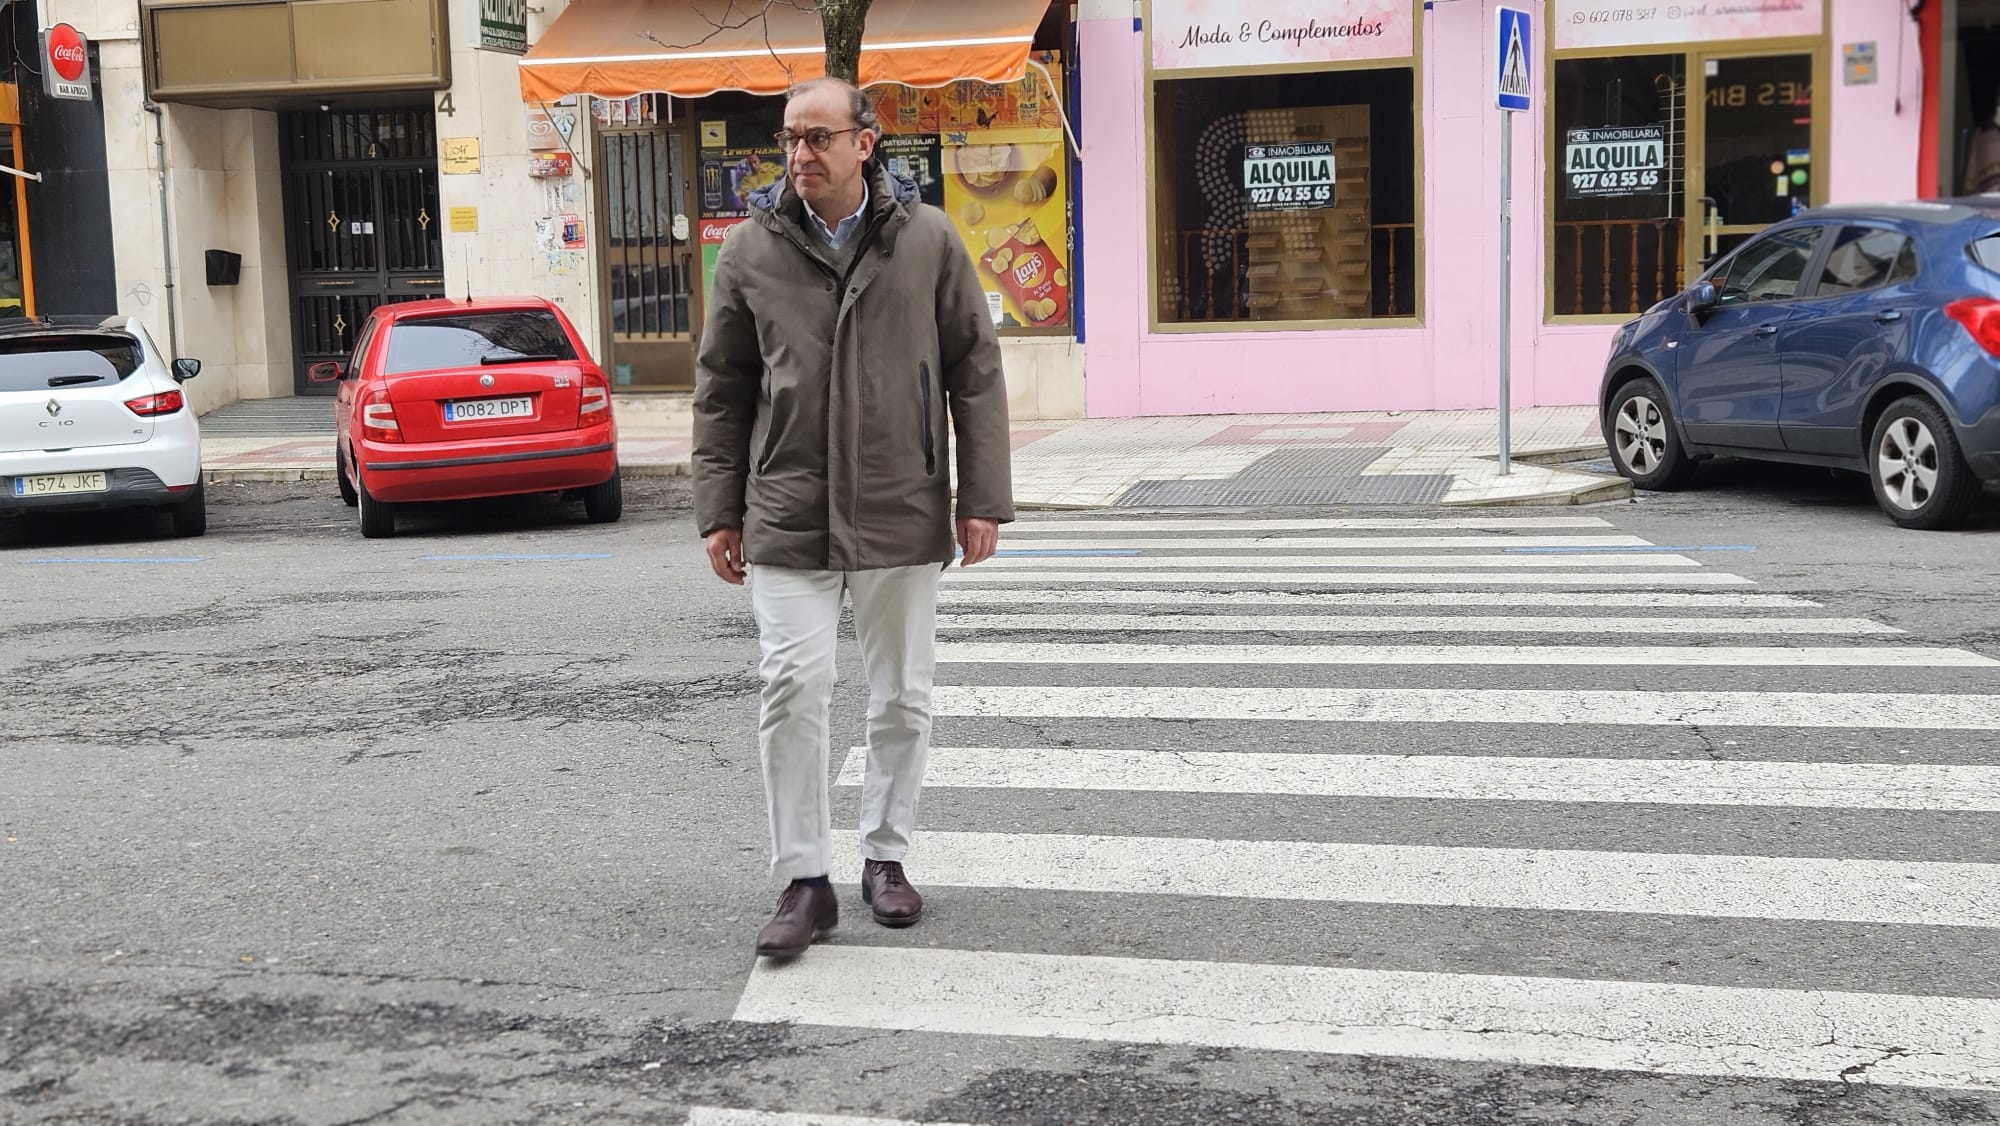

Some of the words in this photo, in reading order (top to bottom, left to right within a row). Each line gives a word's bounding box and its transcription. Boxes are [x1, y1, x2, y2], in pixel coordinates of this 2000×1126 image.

[1590, 10, 1609, 23] 602
[1612, 9, 1633, 21] 078
[1637, 7, 1656, 20] 387
[1179, 24, 1233, 49] Moda
[1239, 22, 1252, 42] &
[1258, 16, 1385, 47] Complementos
[55, 44, 84, 62] Coca-Cola
[437, 92, 456, 117] 4
[913, 138, 936, 146] BAJA?
[1592, 128, 1661, 141] INMOBILIARIA
[367, 143, 377, 158] 4
[754, 147, 783, 155] HAMIL
[1267, 144, 1331, 157] INMOBILIARIA
[1571, 145, 1659, 172] ALQUILA
[1249, 159, 1331, 185] ALQUILA
[1572, 173, 1598, 189] 927
[1600, 172, 1618, 187] 62
[1620, 171, 1638, 186] 55
[1640, 170, 1658, 185] 65
[1251, 188, 1274, 203] 927
[1276, 187, 1293, 202] 62
[1295, 186, 1312, 201] 55
[1314, 185, 1331, 200] 65
[456, 402, 495, 418] 0082
[500, 400, 529, 415] DPT
[38, 420, 74, 428] CIO
[28, 477, 66, 492] 1574
[73, 474, 102, 489] JKF
